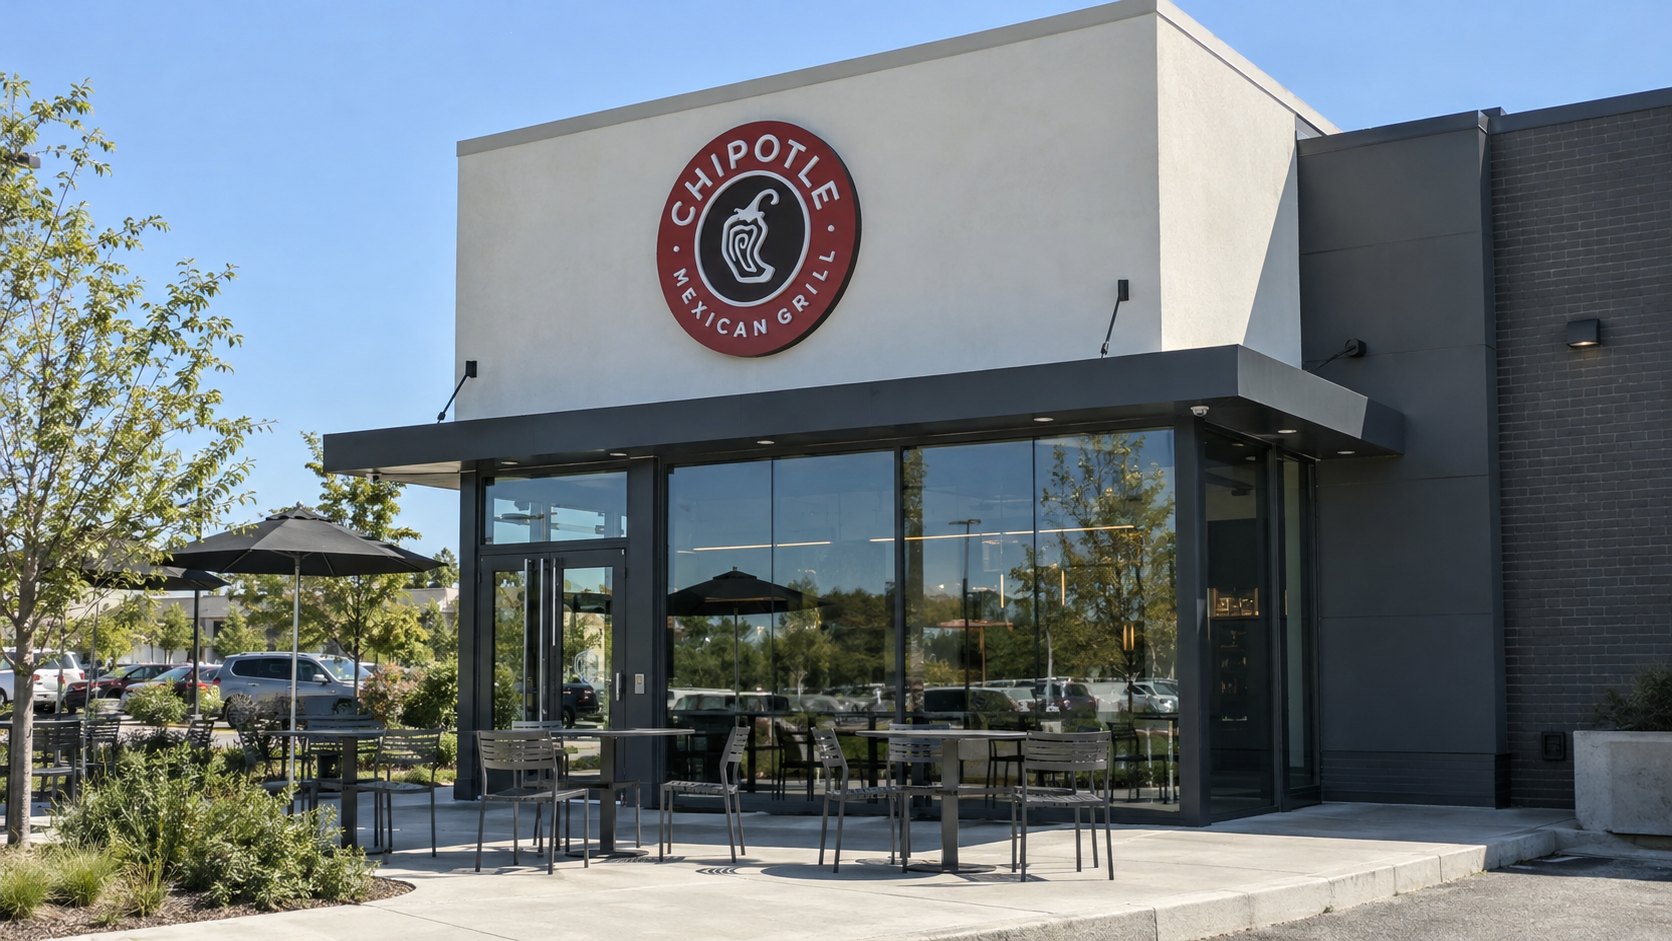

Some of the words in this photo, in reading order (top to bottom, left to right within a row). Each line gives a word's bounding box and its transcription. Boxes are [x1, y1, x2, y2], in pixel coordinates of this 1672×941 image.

[671, 134, 840, 226] CHIPOTLE
[673, 268, 768, 338] MEXICAN
[777, 250, 836, 325] GRILL
